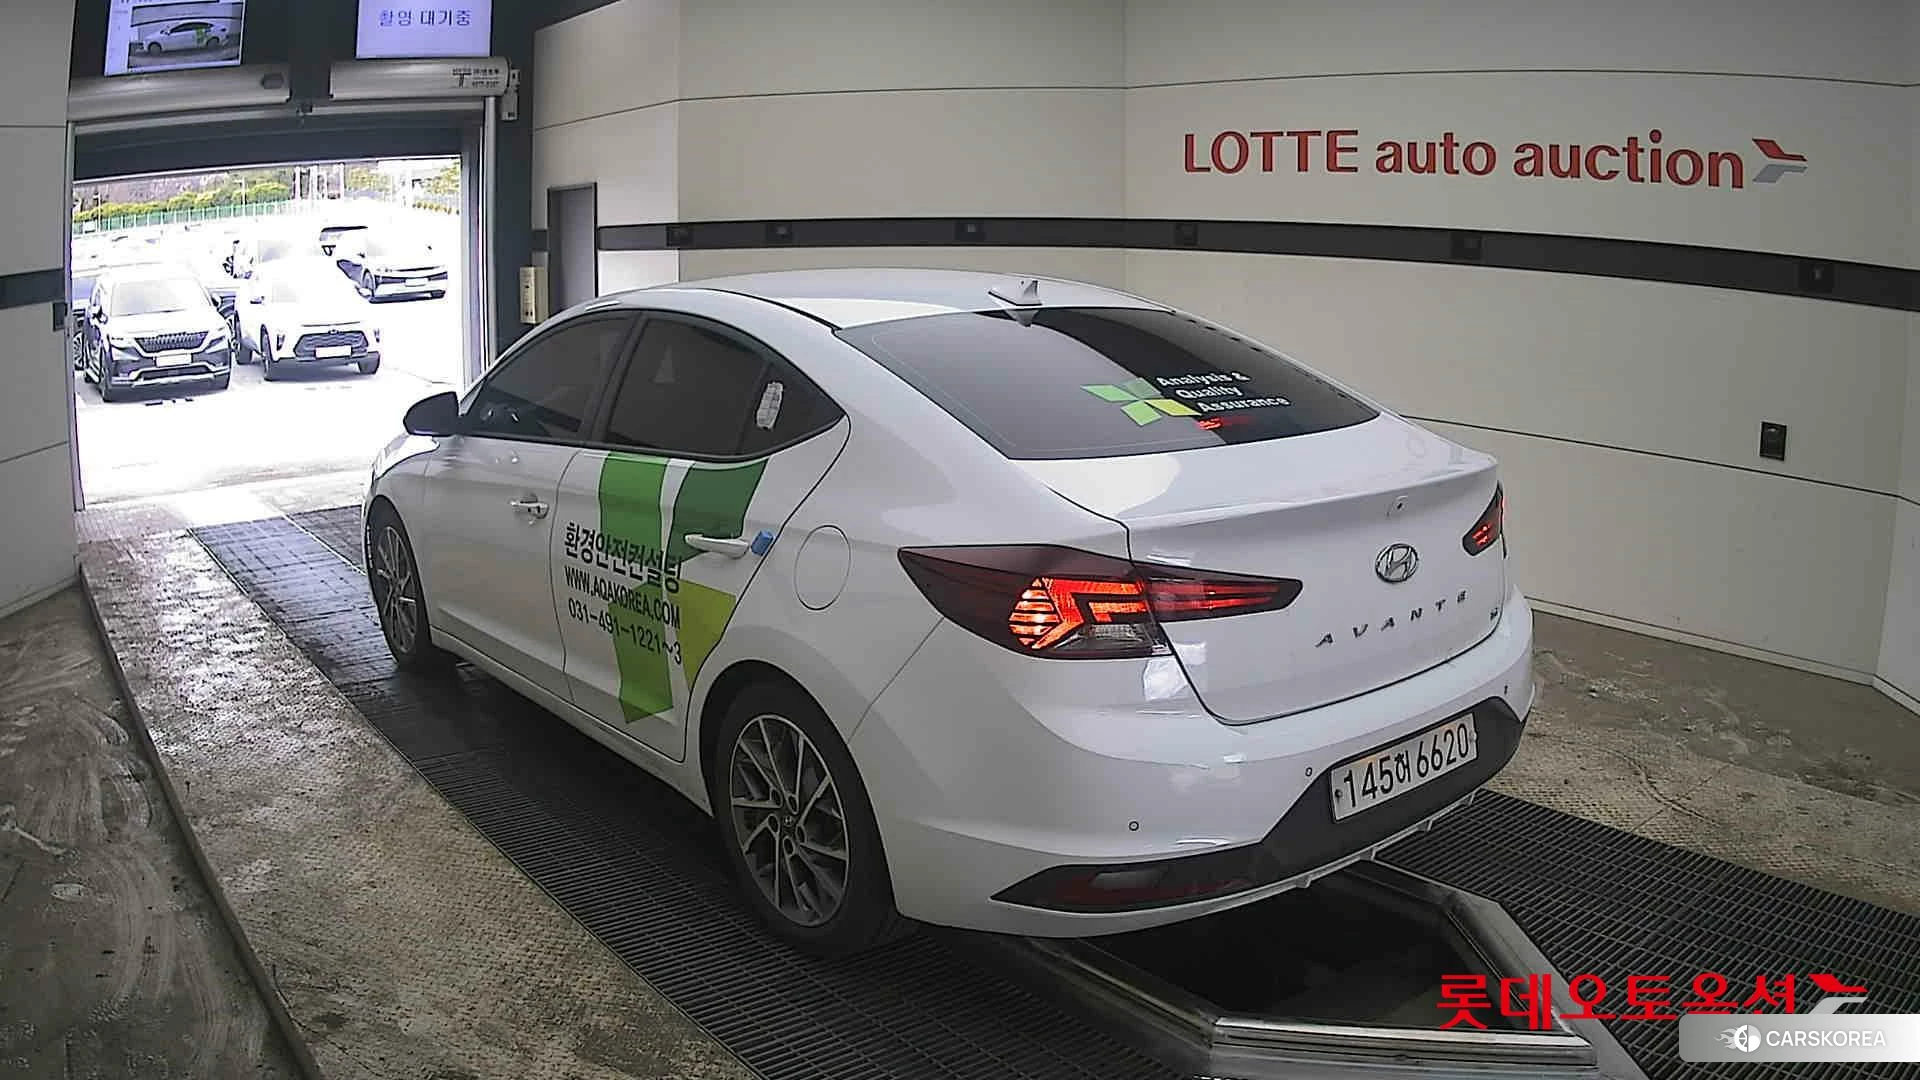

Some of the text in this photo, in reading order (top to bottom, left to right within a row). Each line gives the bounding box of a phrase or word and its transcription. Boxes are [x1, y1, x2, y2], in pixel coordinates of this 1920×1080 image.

[420, 9, 472, 26] 대기중
[1184, 130, 1744, 189] LOTTE auto auction
[1157, 371, 1250, 387] Analysis &
[1176, 385, 1243, 399] Quality
[1197, 397, 1290, 412] Assurance
[565, 522, 681, 594] 환경안전컨설팅
[565, 566, 681, 630] WWW.AQAKOREA.COM
[1315, 590, 1467, 648] AVANTE
[568, 598, 682, 665] 031-491-1221~3
